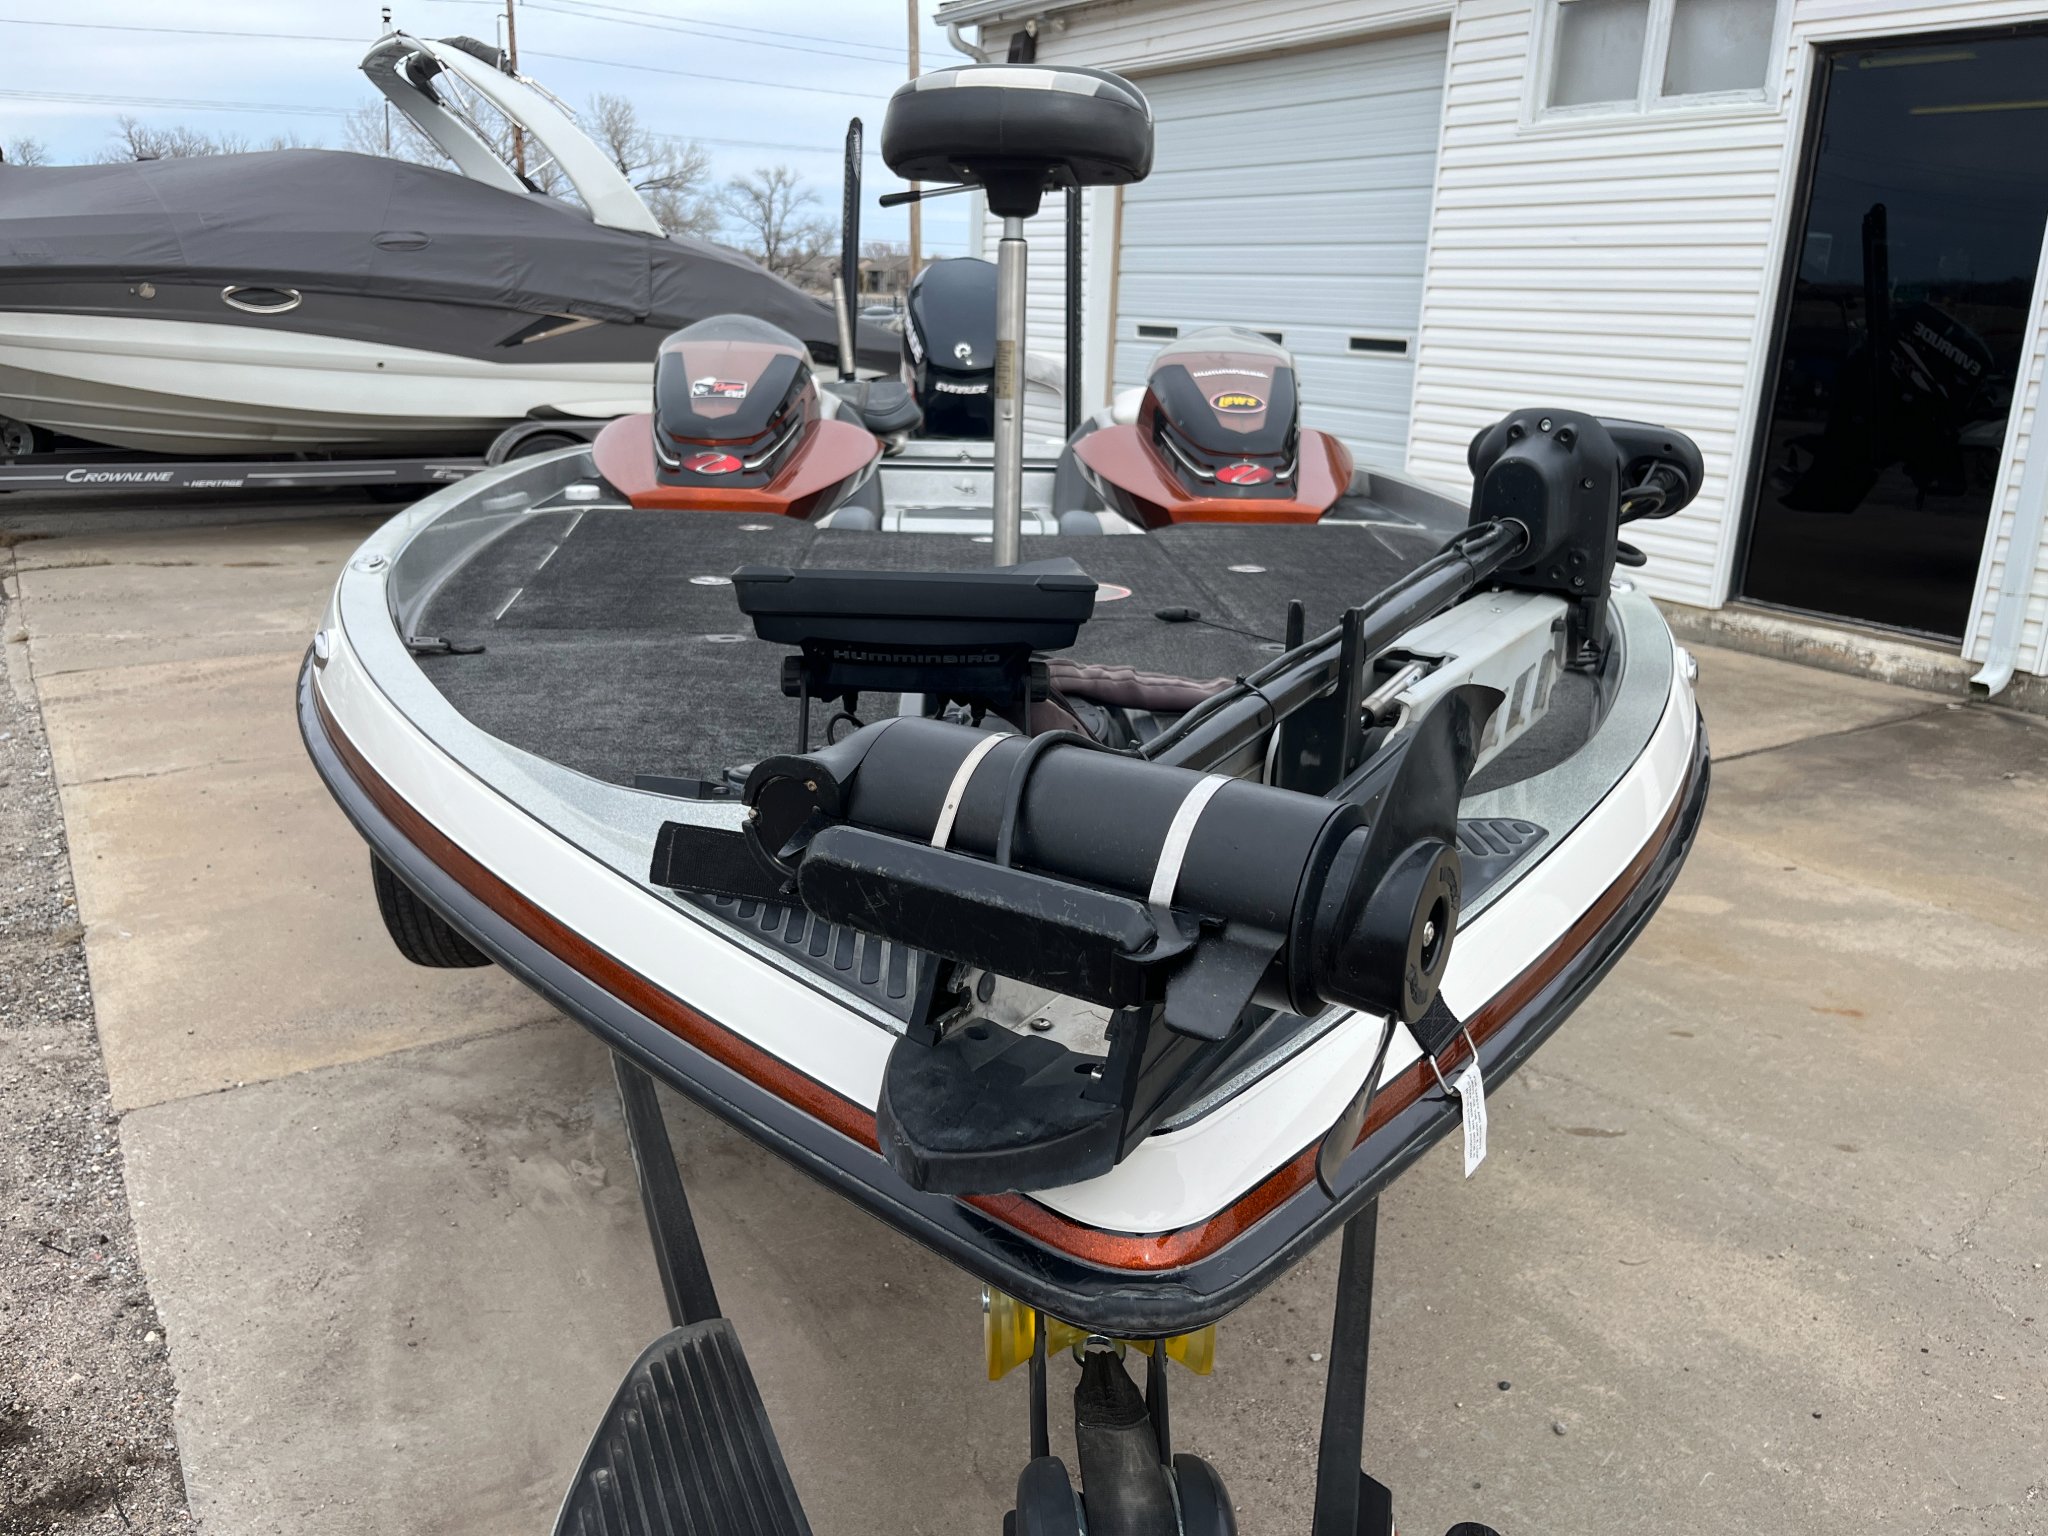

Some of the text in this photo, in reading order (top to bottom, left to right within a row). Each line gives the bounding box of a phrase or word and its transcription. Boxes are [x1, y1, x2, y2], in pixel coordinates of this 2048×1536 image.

[65, 469, 174, 483] CROWNLINE
[191, 479, 244, 488] HERITAGE
[833, 649, 1000, 664] HUMMINBIRD
